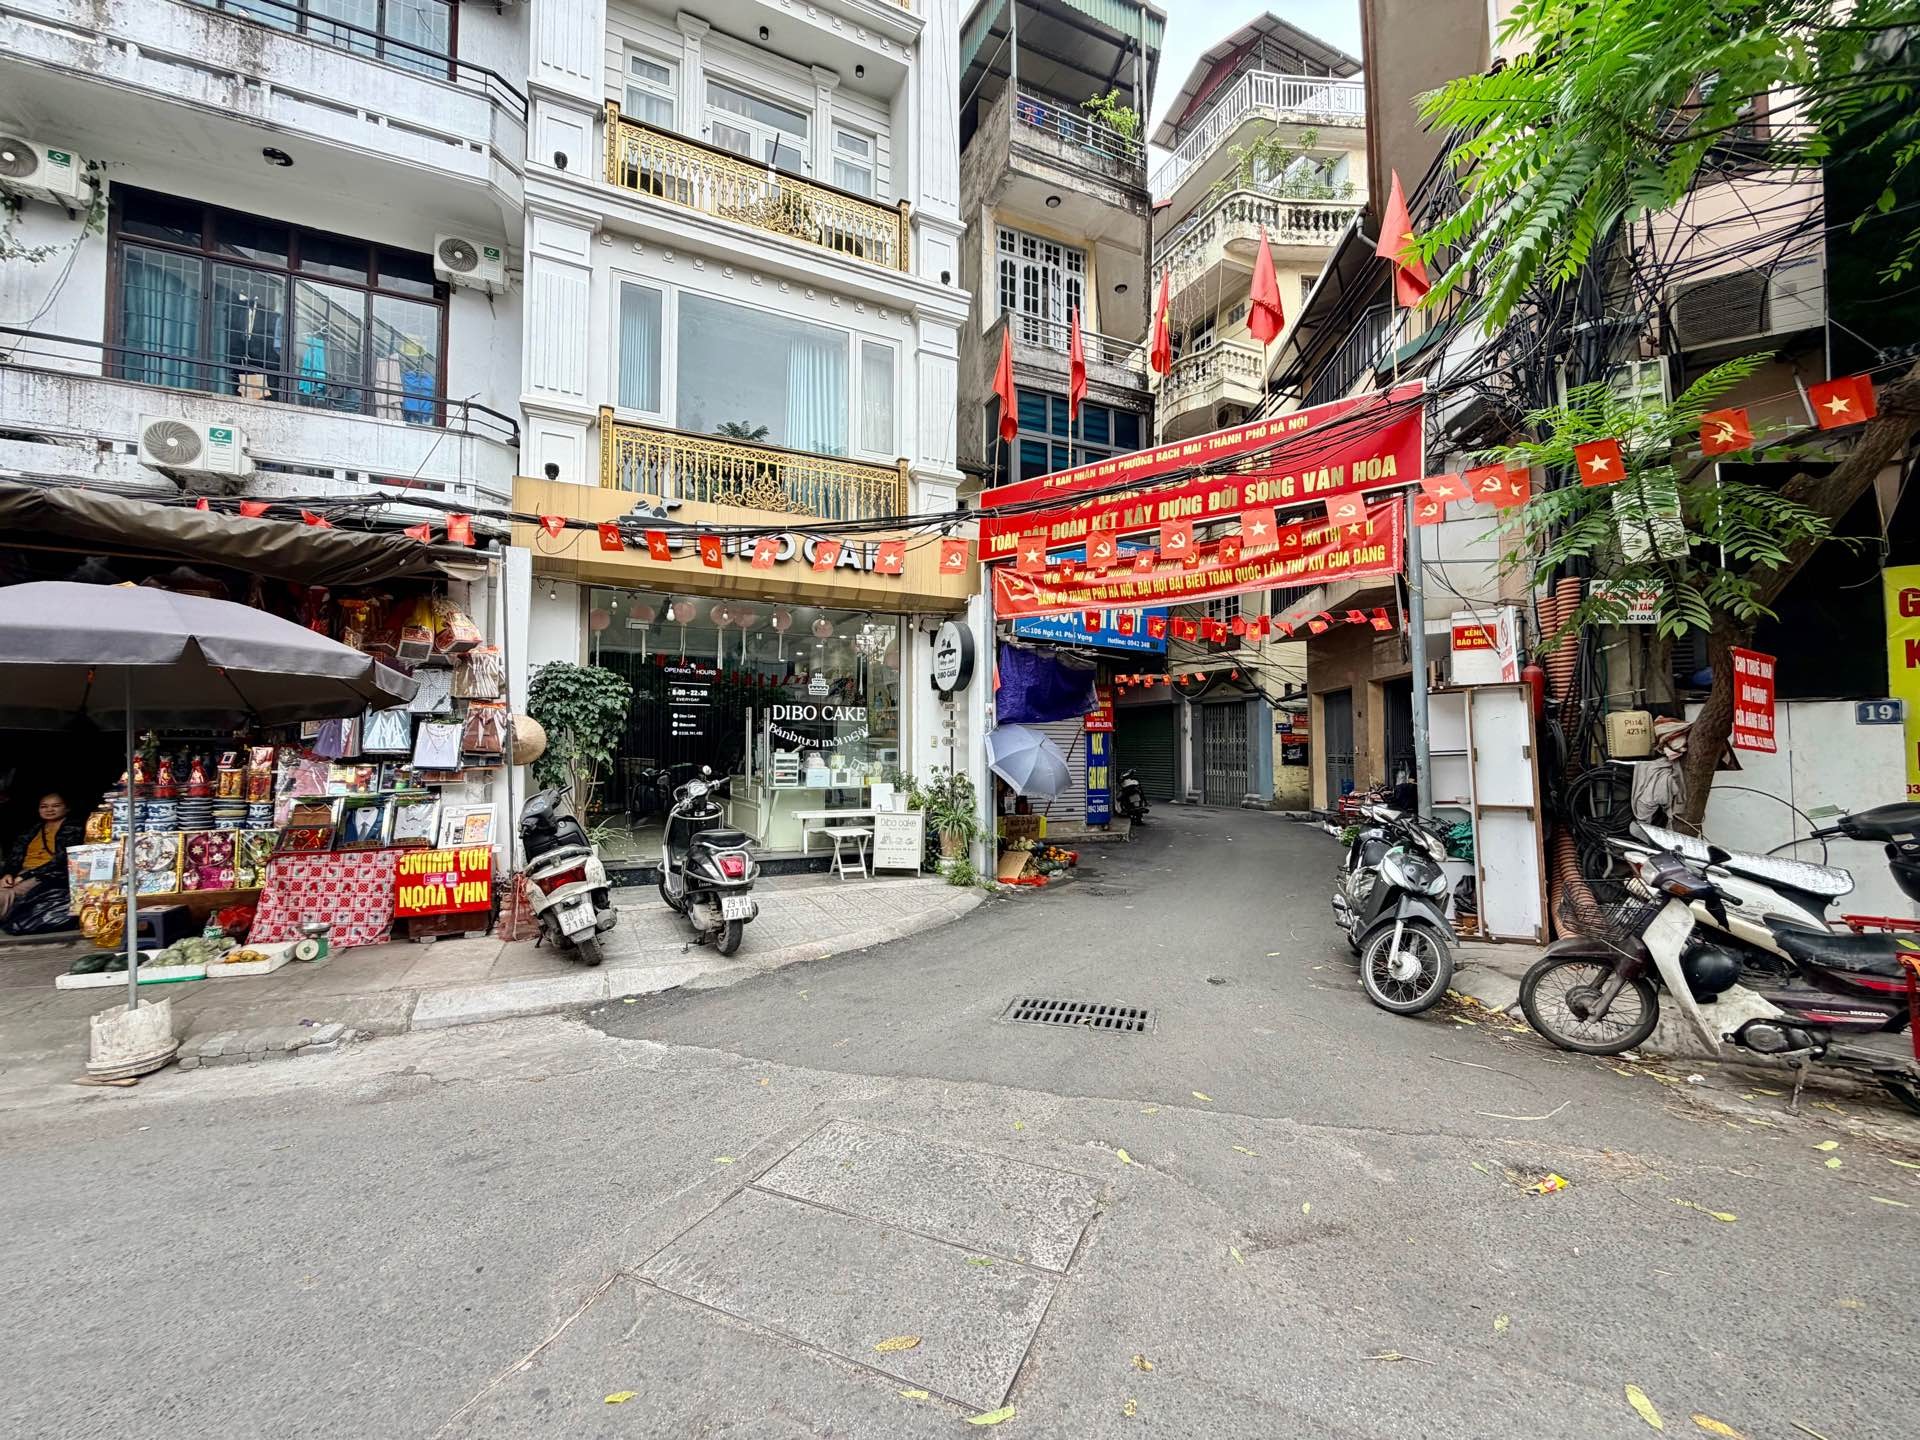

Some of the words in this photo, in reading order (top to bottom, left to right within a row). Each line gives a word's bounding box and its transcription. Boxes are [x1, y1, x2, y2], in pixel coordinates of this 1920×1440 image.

[1055, 474, 1072, 487] BAN
[1073, 467, 1096, 482] NHÂN
[1118, 454, 1153, 471] PHƯỜNG
[1155, 447, 1180, 464] BẠCH
[1183, 441, 1202, 456] MAI
[1208, 430, 1242, 450] THÀNH
[1245, 422, 1267, 441] PHỐ
[1269, 419, 1285, 434] HÀ
[1288, 415, 1309, 432] NỘI
[990, 530, 1019, 553] TOÀN
[1091, 510, 1119, 532] KẾT
[1124, 503, 1154, 527] XÂY
[1158, 494, 1204, 522] DỰNG
[1208, 484, 1238, 512] ĐỜI
[1302, 465, 1345, 493] VĂN
[1352, 452, 1398, 484] HÓA
[1068, 587, 1092, 603] THÀNH
[1092, 583, 1108, 600] PHỐ
[1108, 582, 1119, 598] HÀ
[1120, 581, 1137, 599] NỘI,
[1138, 580, 1154, 597] ĐẠI
[1153, 577, 1168, 595] HỘI
[1169, 575, 1184, 593] ĐẠI
[1186, 568, 1207, 588] BIỂU
[1208, 567, 1234, 586] TOÀN
[1234, 560, 1262, 582] QUỐC
[1263, 556, 1284, 577] LẦN
[1286, 551, 1306, 575] THỨ
[1308, 553, 1325, 572] XIV
[1328, 545, 1350, 568] CỦA
[1353, 540, 1386, 564] ĐẢNG
[1030, 627, 1042, 635] 106
[1042, 628, 1055, 638] Ngõ
[1077, 632, 1093, 642] Vọng
[1107, 637, 1127, 646] Hotline:
[1456, 637, 1472, 646] BÁO
[664, 666, 692, 674] OPENING
[1747, 657, 1760, 677] THUÊ
[772, 704, 818, 721] DIBO
[821, 705, 867, 721] CAKE
[1865, 703, 1894, 721] 19
[399, 884, 448, 913] VƯỜN
[453, 880, 488, 909] NHÀ
[1849, 1010, 1889, 1018] HONDA
